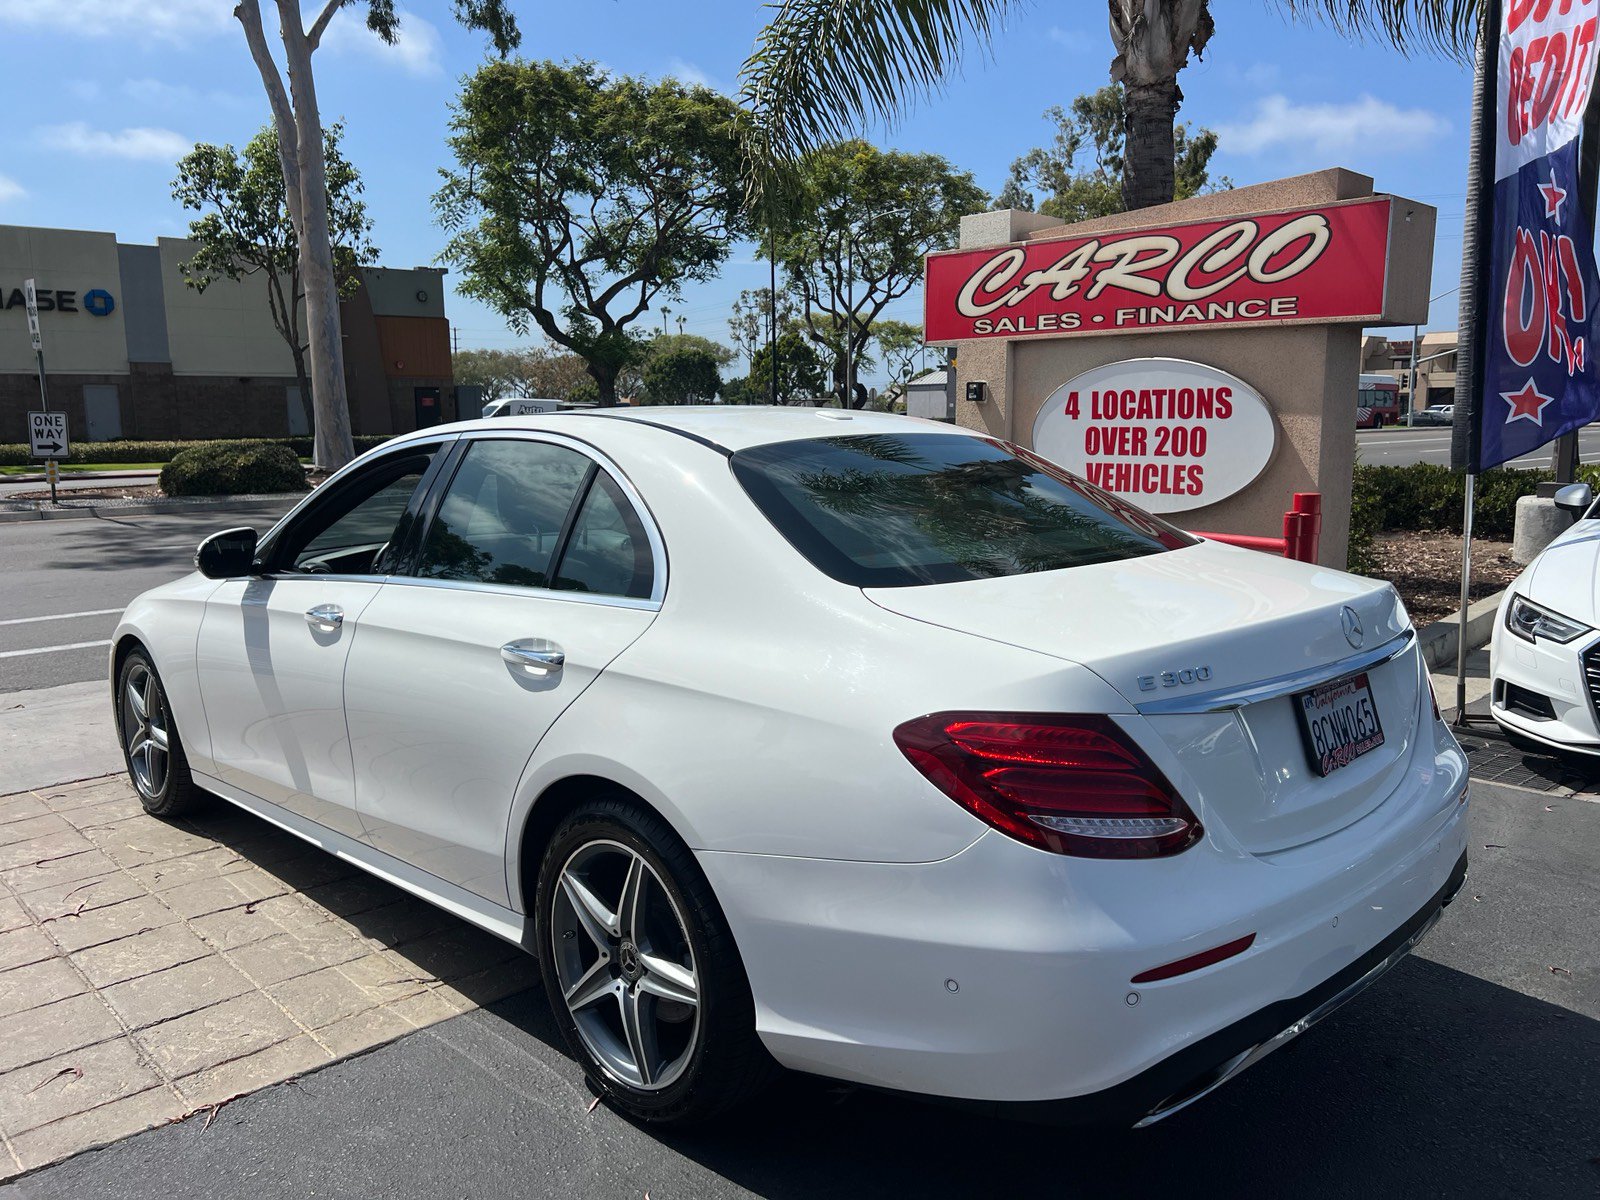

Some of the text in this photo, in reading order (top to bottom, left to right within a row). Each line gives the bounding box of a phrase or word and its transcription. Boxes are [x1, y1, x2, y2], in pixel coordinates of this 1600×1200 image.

[957, 213, 1332, 318] CARCO
[0, 288, 78, 312] ASE
[973, 296, 1299, 335] SALES FINANCE
[1503, 225, 1587, 377] OK!
[1064, 387, 1233, 420] 4 LOCATIONS
[34, 416, 63, 427] ONE
[34, 428, 64, 439] WAY
[1085, 426, 1207, 458] OVER 200
[1086, 464, 1204, 496] VEHICLES
[1137, 666, 1213, 691] E 300
[1312, 697, 1376, 757] 8CNW065
